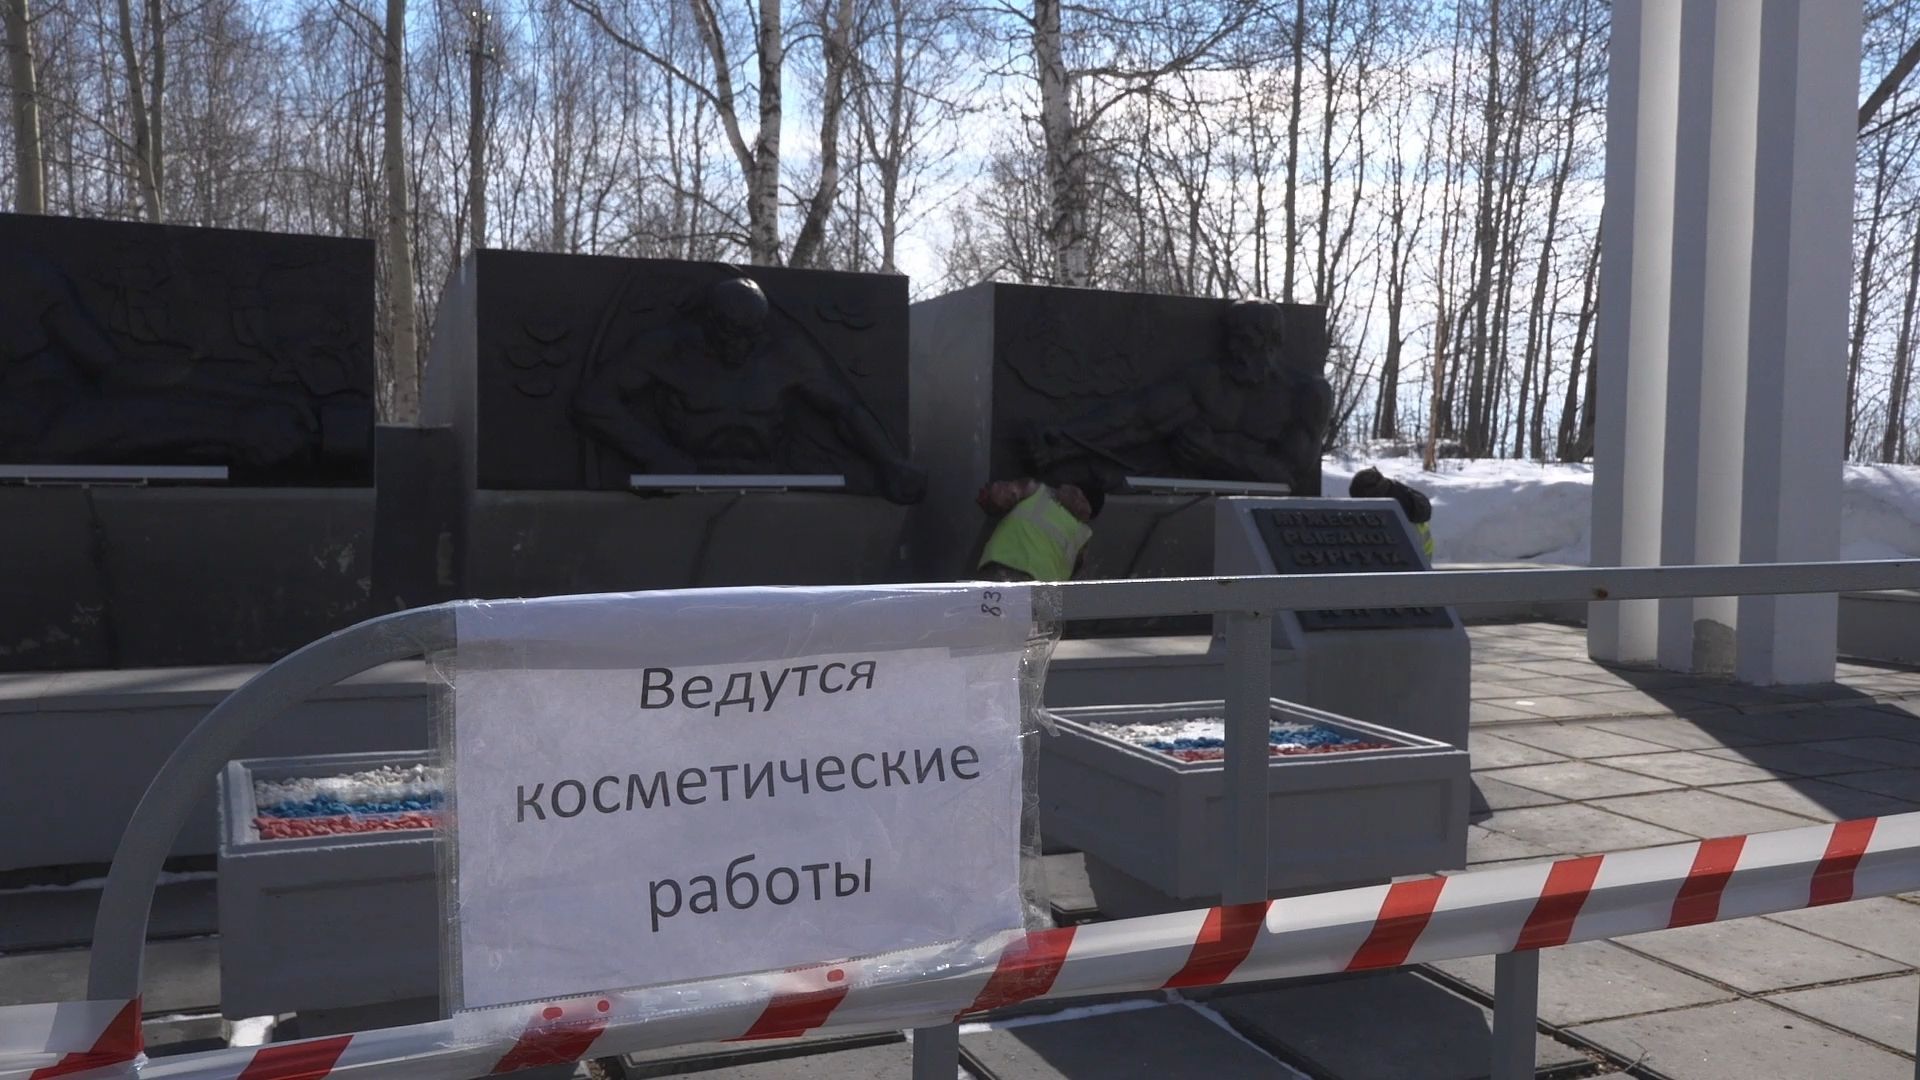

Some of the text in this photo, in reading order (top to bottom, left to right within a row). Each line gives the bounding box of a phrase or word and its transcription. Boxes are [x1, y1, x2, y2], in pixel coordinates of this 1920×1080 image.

[640, 659, 878, 717] Ведутся
[516, 744, 982, 824] косметические
[648, 853, 873, 933] работы
